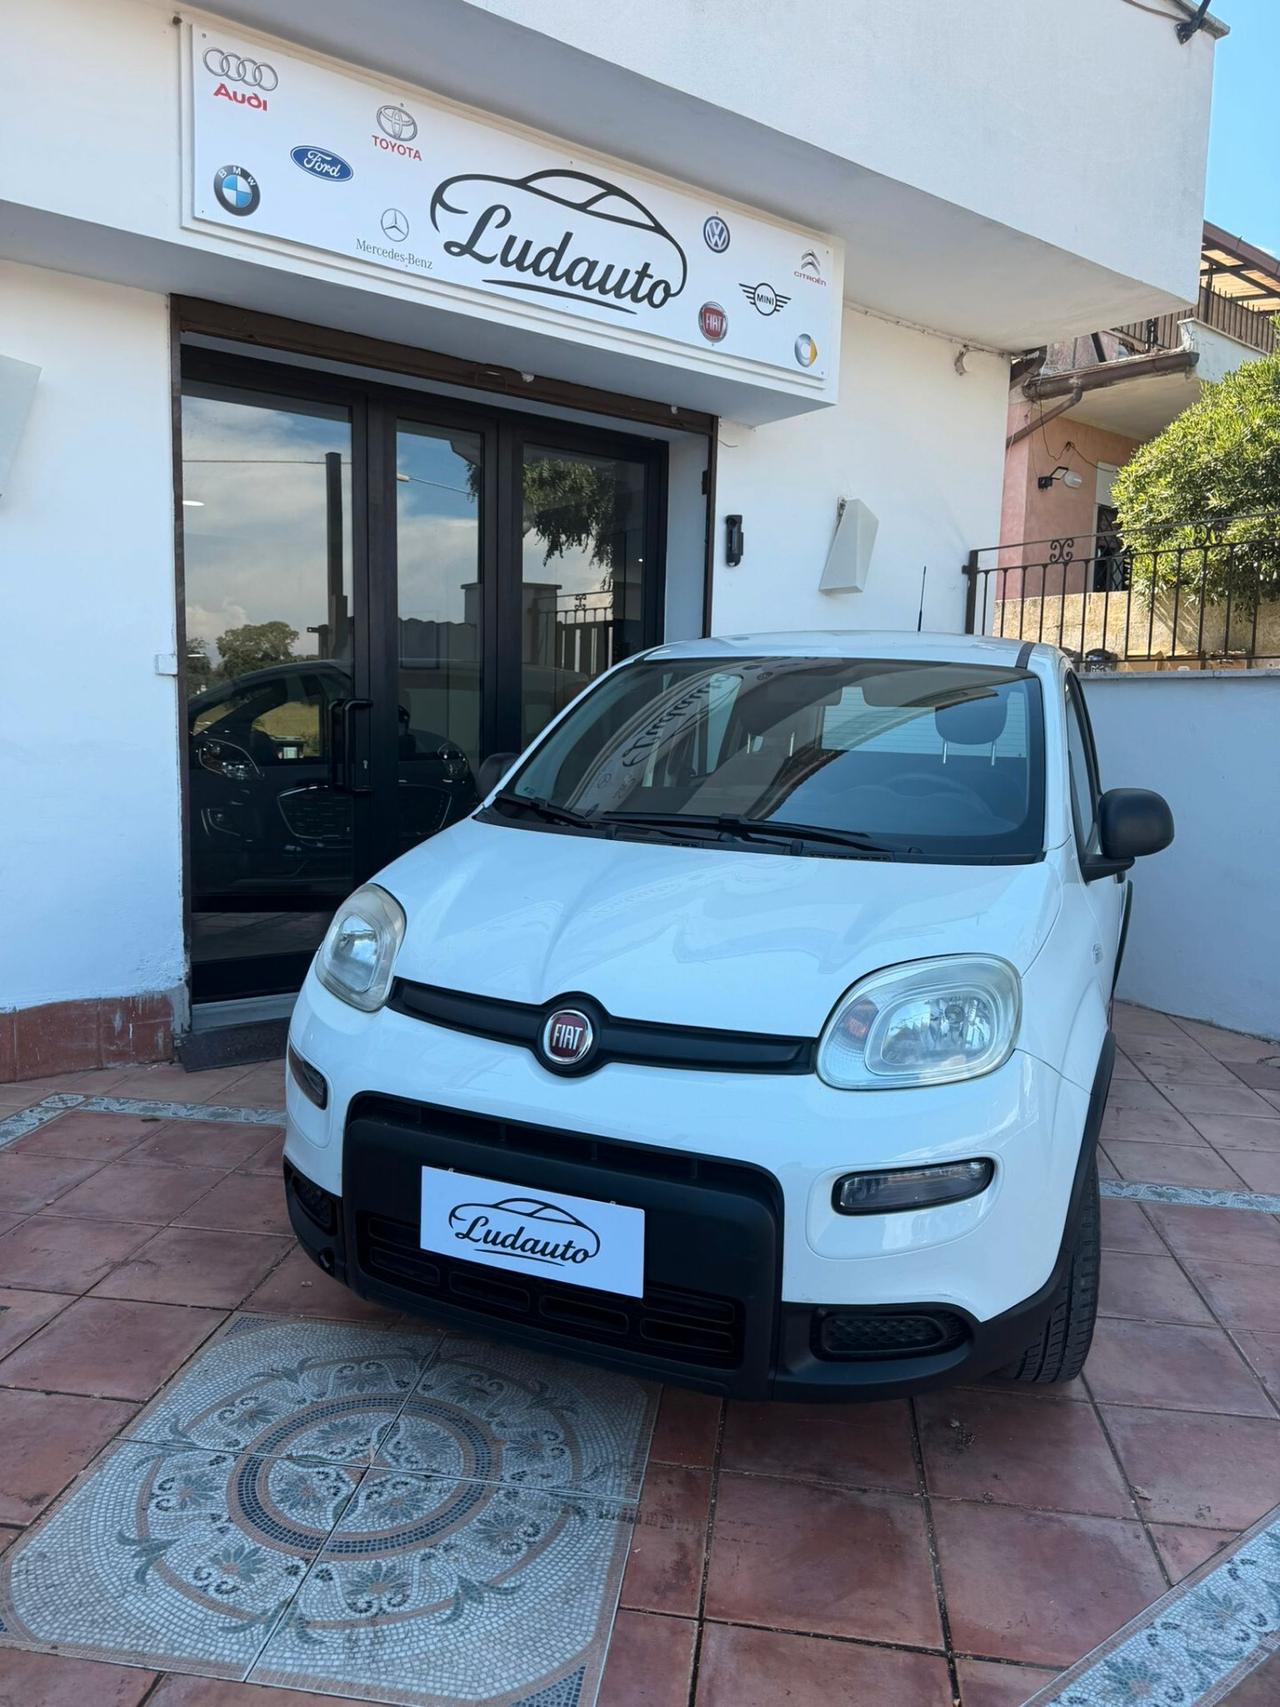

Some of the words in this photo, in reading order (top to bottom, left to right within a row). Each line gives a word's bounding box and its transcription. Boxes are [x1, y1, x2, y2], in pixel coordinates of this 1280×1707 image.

[213, 82, 268, 111] Audi
[371, 135, 422, 161] TOYOTA
[219, 166, 256, 186] BMW
[303, 150, 341, 177] Ford
[356, 238, 433, 270] Mercedes-Benz
[443, 204, 671, 309] Ludauto
[756, 293, 775, 306] MINI
[705, 313, 722, 331] FIAT
[552, 1023, 583, 1050] FIAT
[455, 1215, 590, 1264] Ludauto
